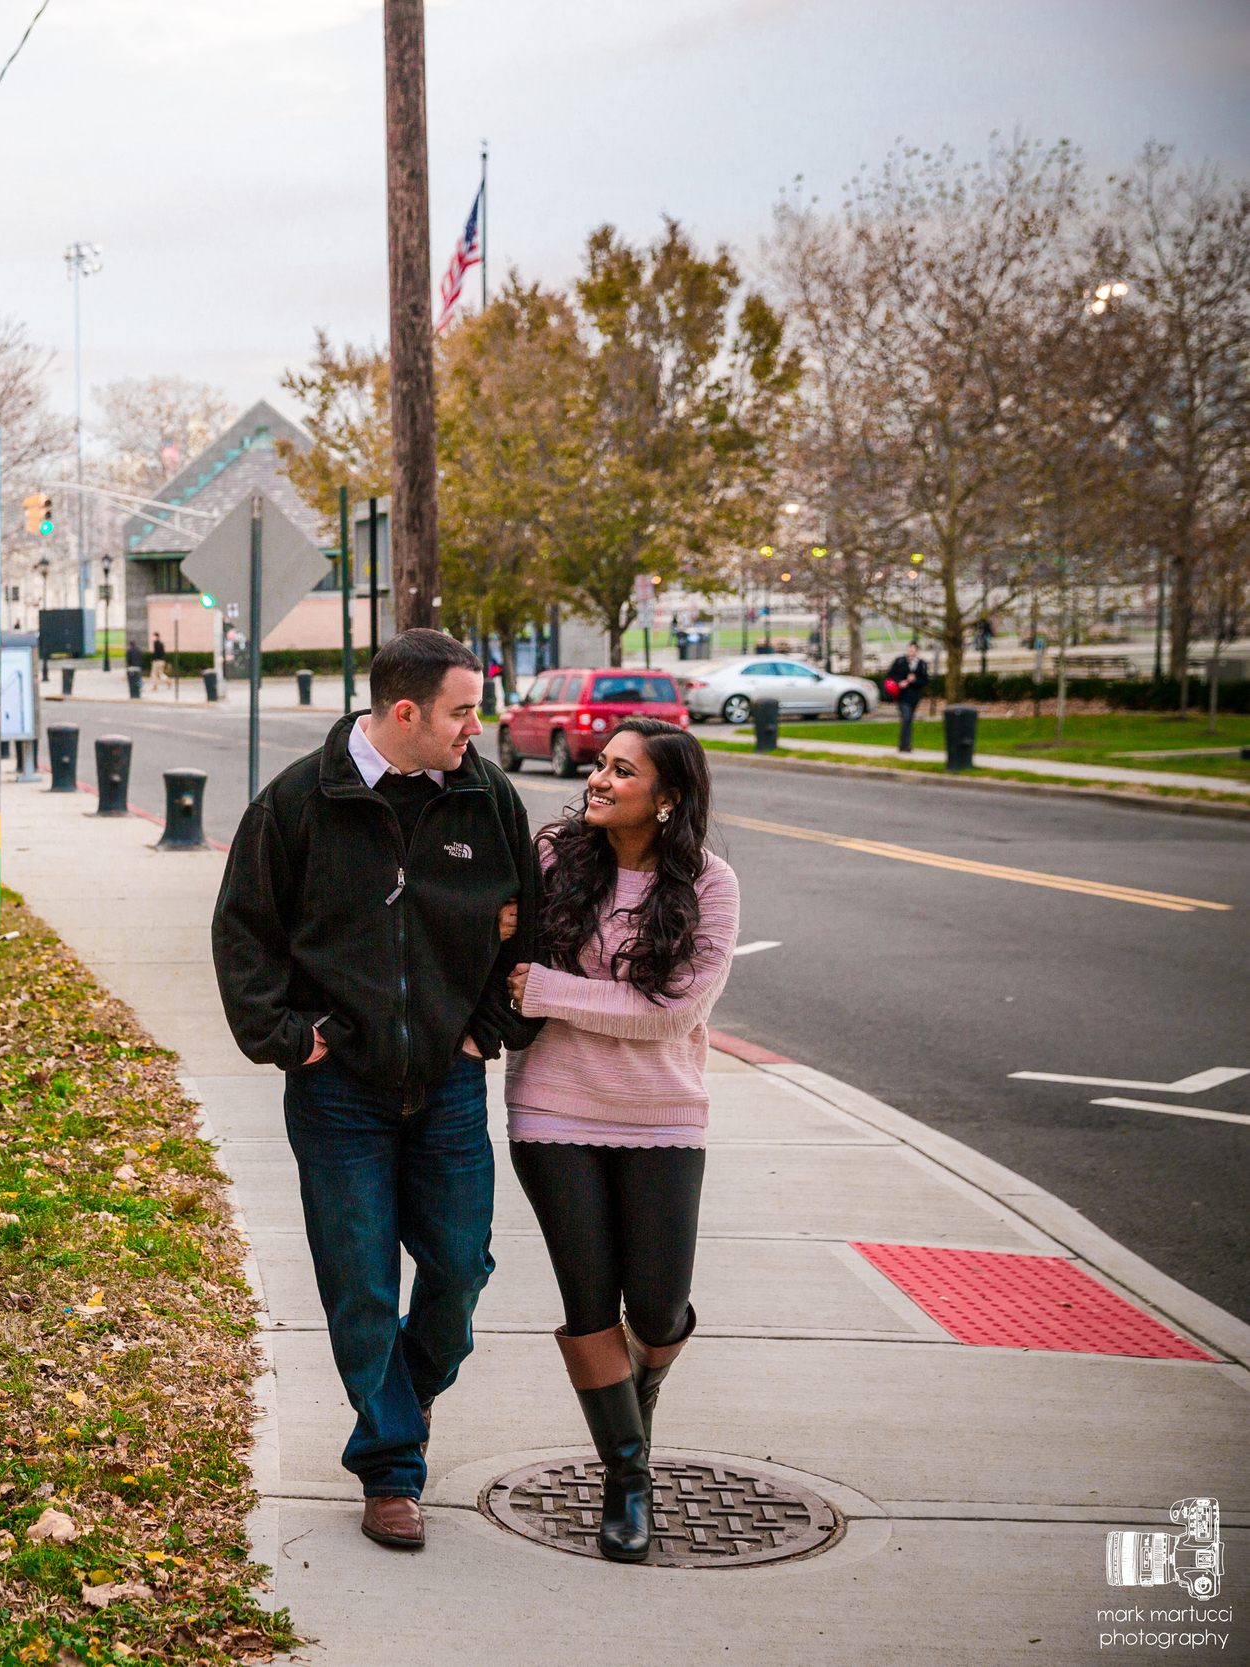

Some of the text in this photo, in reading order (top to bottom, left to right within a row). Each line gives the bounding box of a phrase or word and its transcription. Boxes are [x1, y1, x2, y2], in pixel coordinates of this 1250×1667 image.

[443, 844, 462, 853] NORTH
[453, 841, 462, 849] THE
[448, 850, 461, 858] FACE
